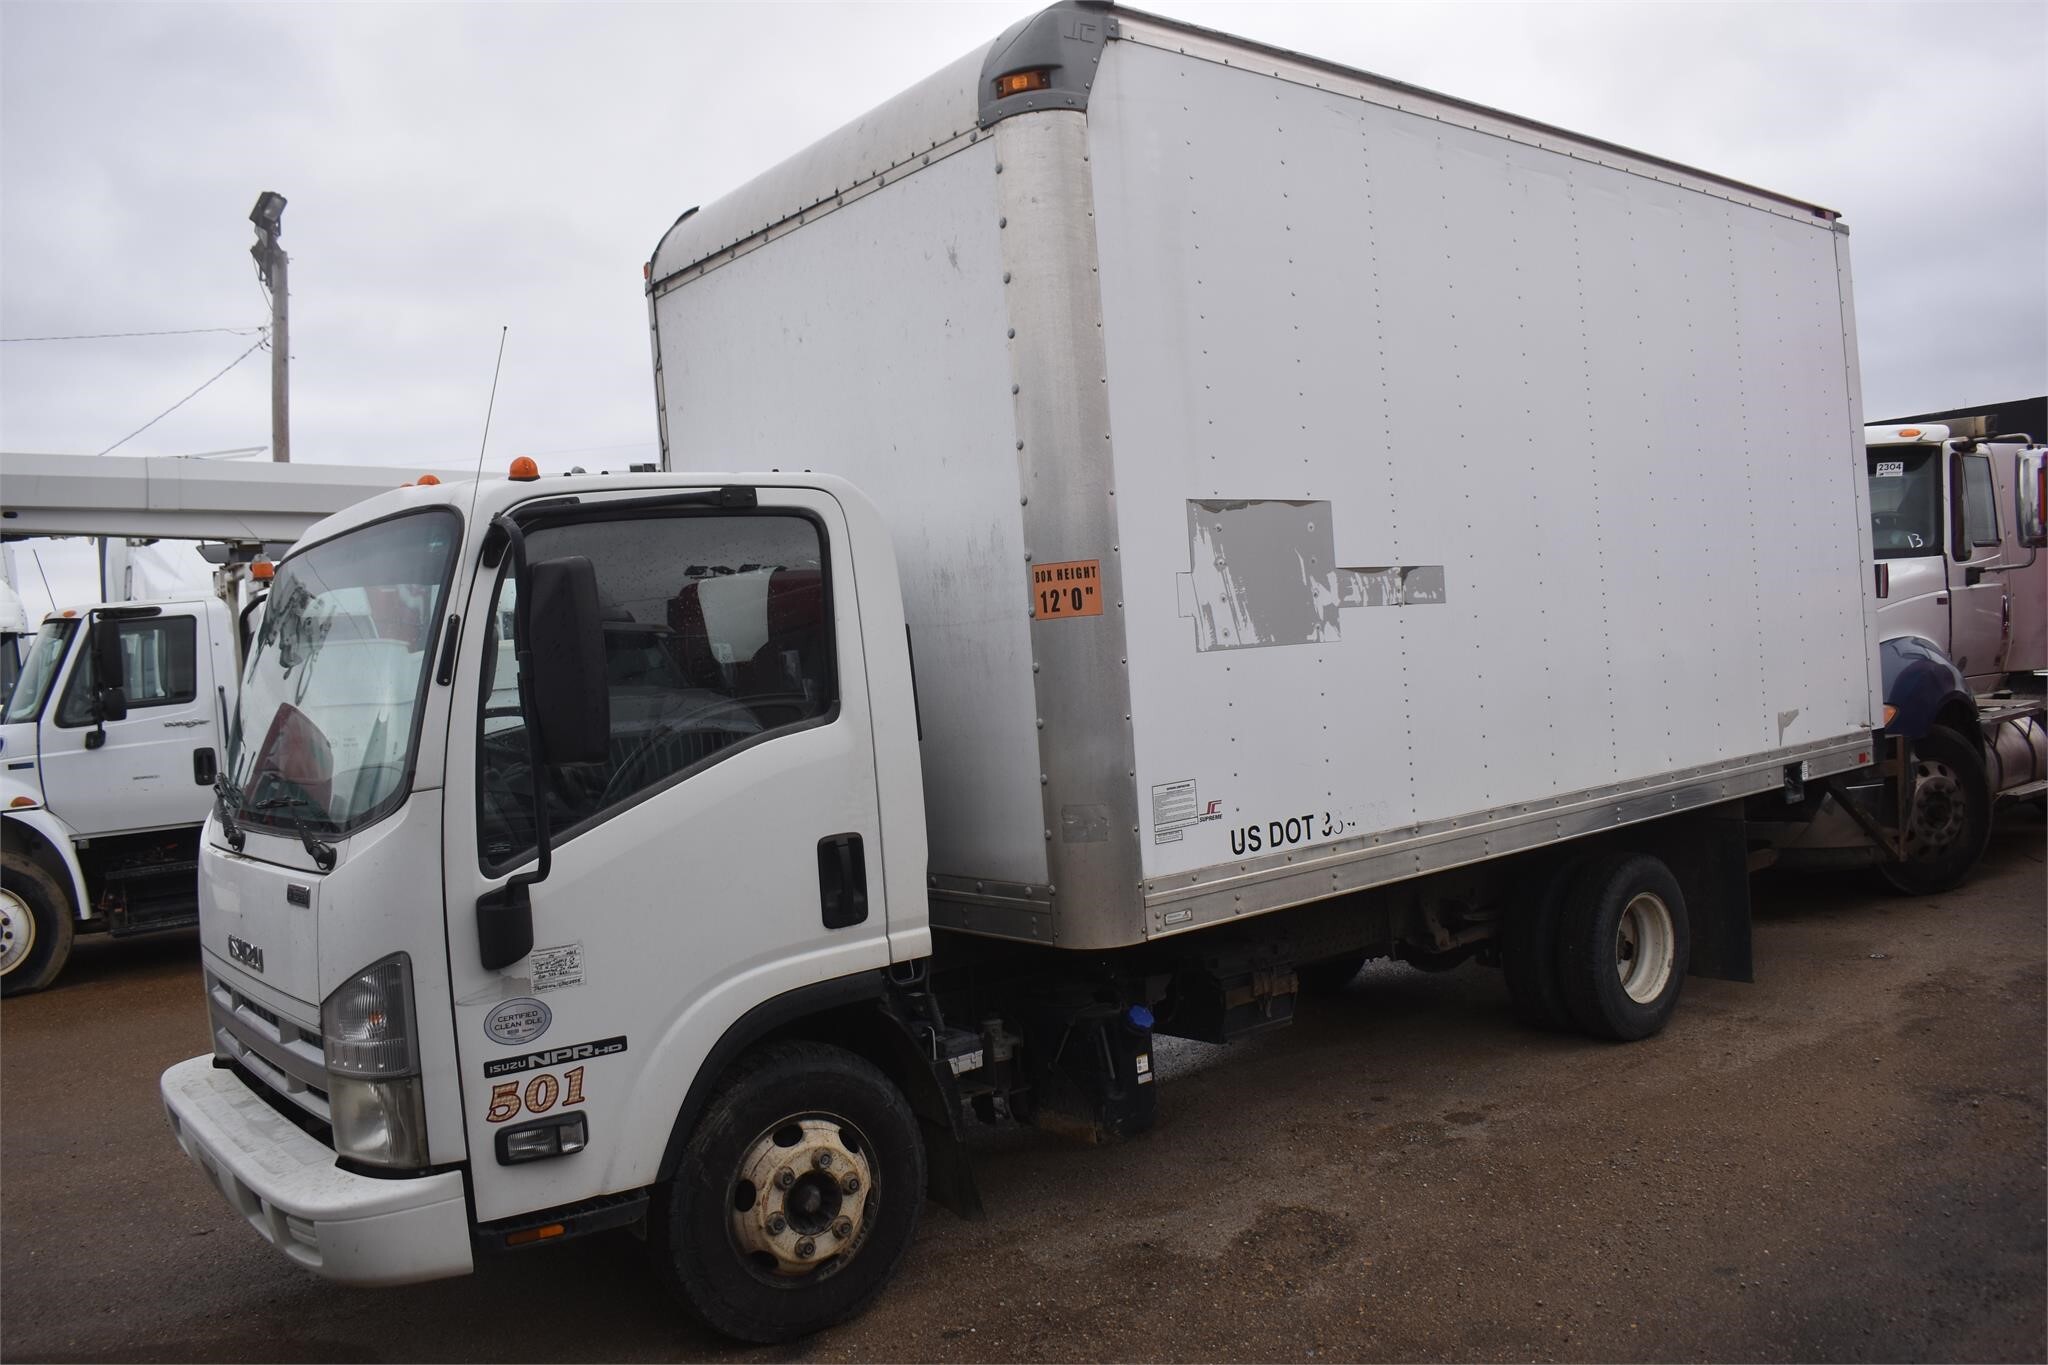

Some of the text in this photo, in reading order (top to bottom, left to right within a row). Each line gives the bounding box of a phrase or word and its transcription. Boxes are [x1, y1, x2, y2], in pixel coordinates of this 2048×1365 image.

[1879, 463, 1902, 471] 2304
[1907, 533, 1924, 548] 13
[1035, 566, 1097, 583] BOX HEIGHT
[1040, 586, 1094, 613] 12'0"
[1199, 813, 1223, 823] SUPREME
[1230, 825, 1262, 855] US
[1269, 814, 1315, 848] DOT
[494, 1020, 522, 1031] CLEAN
[525, 1016, 543, 1026] IDLE
[497, 1010, 538, 1023] CERTIFIED
[528, 1043, 594, 1068] NPR
[486, 1066, 586, 1123] 501
